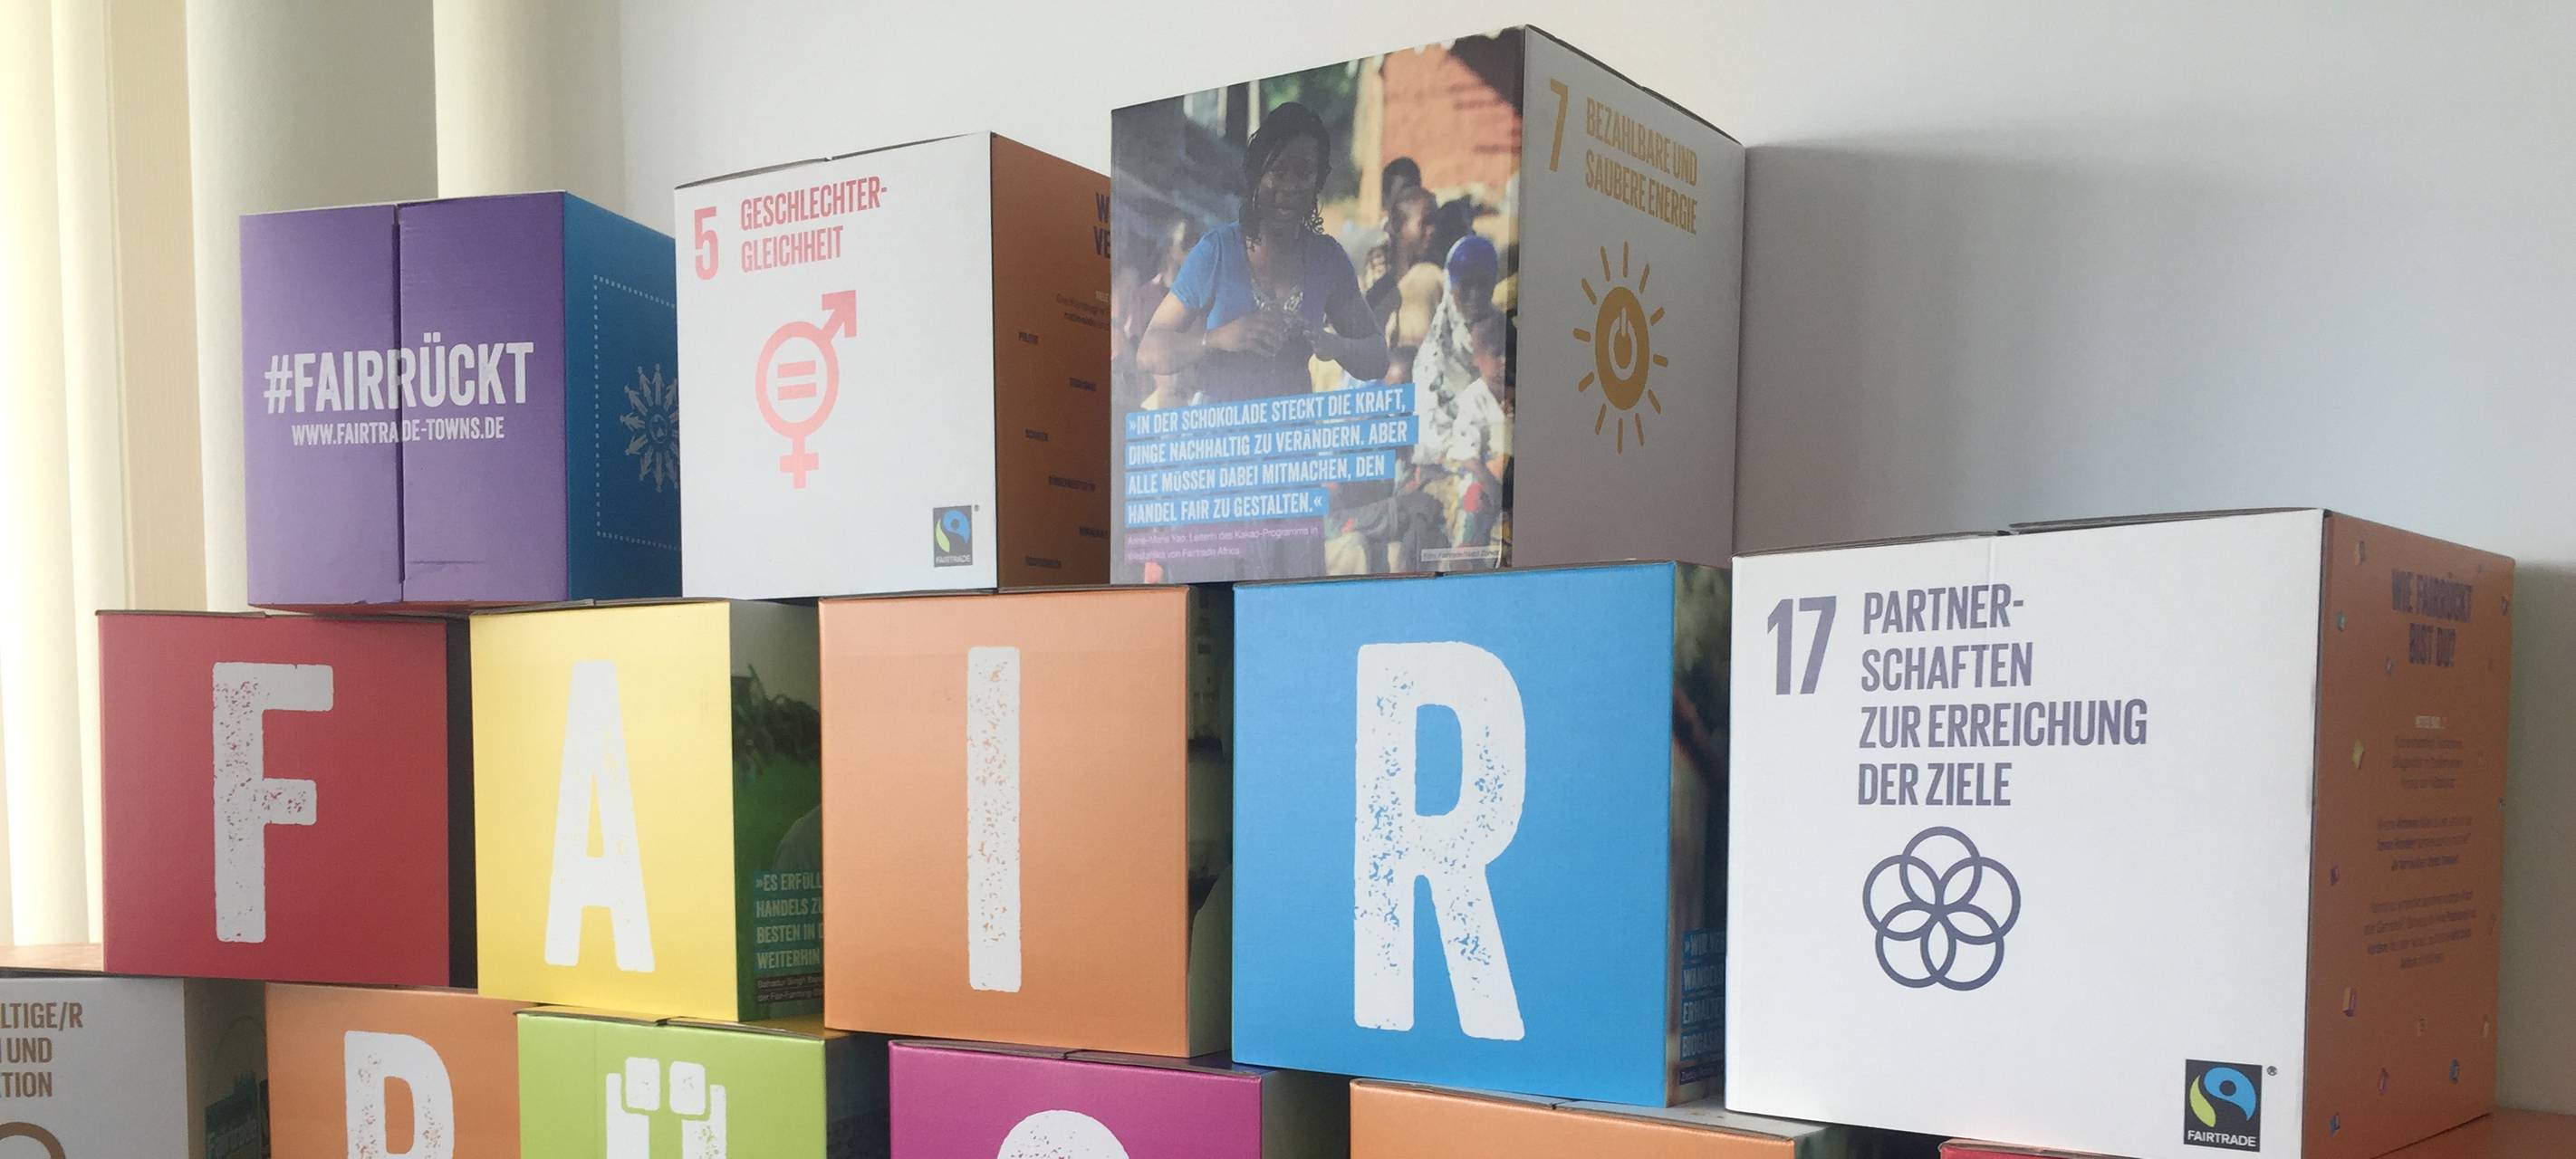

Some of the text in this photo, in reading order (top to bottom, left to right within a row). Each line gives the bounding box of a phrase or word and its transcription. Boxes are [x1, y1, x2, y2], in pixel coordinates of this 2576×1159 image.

[1550, 78, 1697, 187] 7 BEZAHLBARE UND
[1586, 148, 1697, 235] SAUBERE ENERGIE
[694, 175, 888, 281] 5 GESCHLECHTER-
[741, 225, 843, 272] GLEICHHEIT
[263, 331, 534, 414] #FAIRRÜCKT
[292, 416, 505, 446] WWW.FAIRTRADE-TOWNS.DE
[1154, 411, 1177, 434] DER
[1181, 402, 1267, 431] SCHOKOLADE
[1271, 397, 1324, 423] STECKT
[1328, 393, 1351, 417] DIE
[1355, 388, 1406, 414] KRAFT,
[1129, 420, 1408, 465] DINGE NACHHALTIG ZU VERÄNDERN. ABER
[1129, 455, 1385, 496] ALLE MÜSSEN DABEI MITMACHEN, DEN
[1128, 501, 1177, 525] HANDEL
[1180, 499, 1209, 522] FAIR
[1213, 497, 1230, 519] ZU
[1767, 583, 2024, 695] 17 PARTNER-
[1860, 641, 2033, 693] SCHAFTEN
[1859, 698, 2148, 749] ZUR ERREICHUNG
[1858, 761, 2013, 806] DER ZIELE
[756, 897, 809, 918] HANDELS
[756, 924, 801, 943] BESTEN
[803, 923, 815, 940] IN
[756, 948, 821, 970] WEITERHIN
[6, 1037, 53, 1064] UND
[2187, 1129, 2256, 1147] FAIRTRADE
